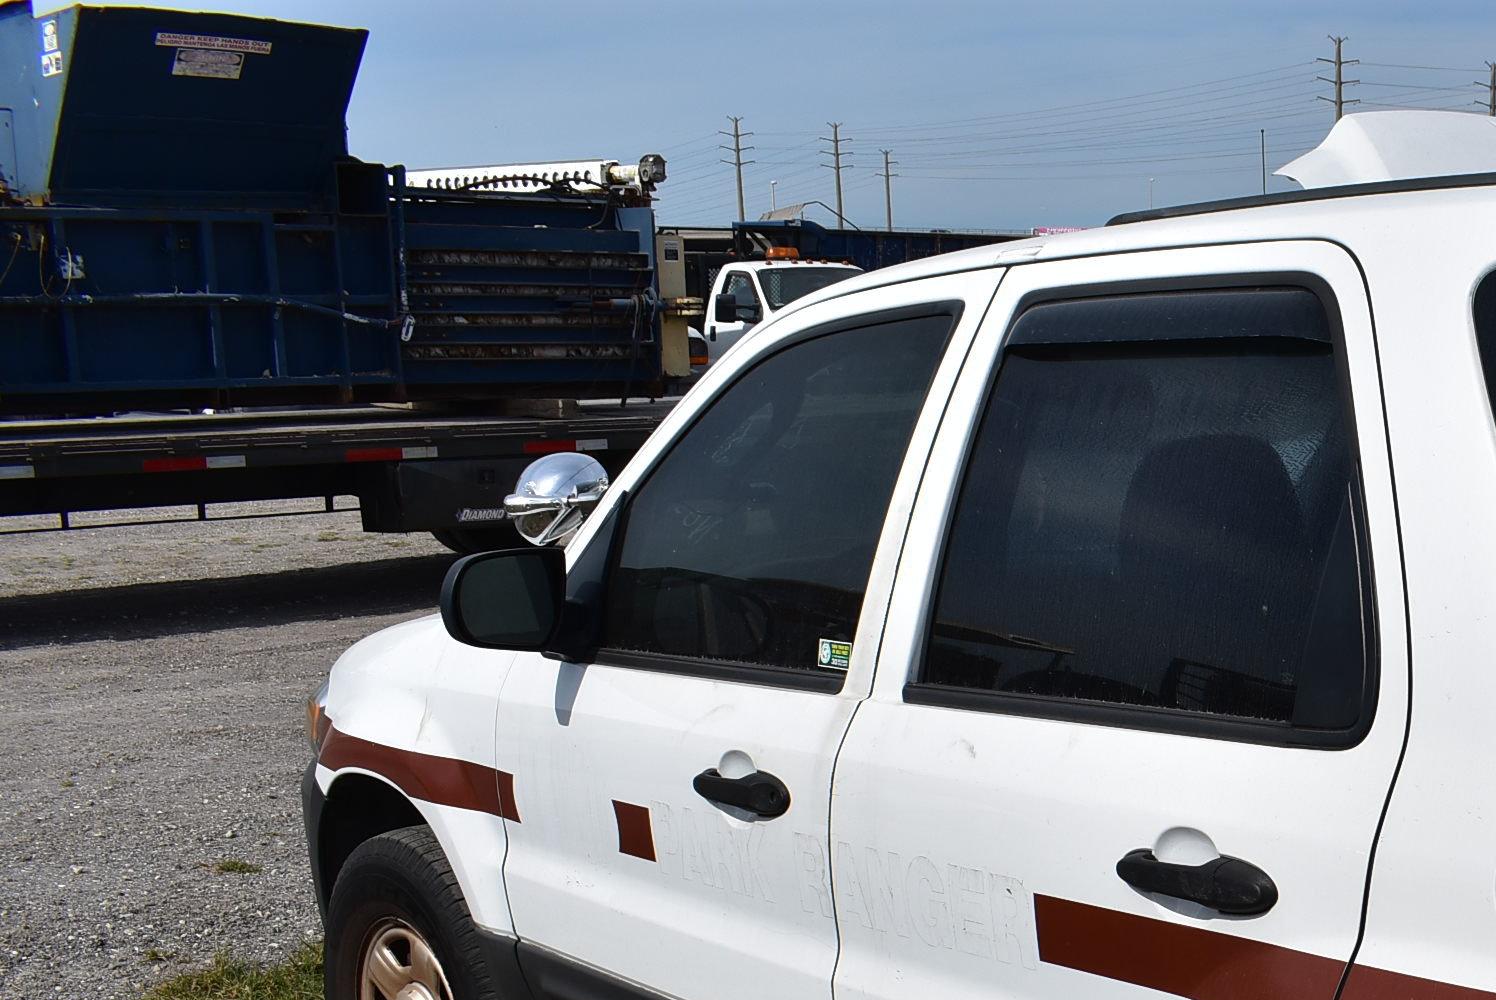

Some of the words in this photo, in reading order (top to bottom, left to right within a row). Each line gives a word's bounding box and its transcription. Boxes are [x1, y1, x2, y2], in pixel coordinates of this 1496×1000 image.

[159, 33, 195, 41] DANGER
[221, 38, 250, 46] HANDS
[792, 831, 1038, 972] RANGER
